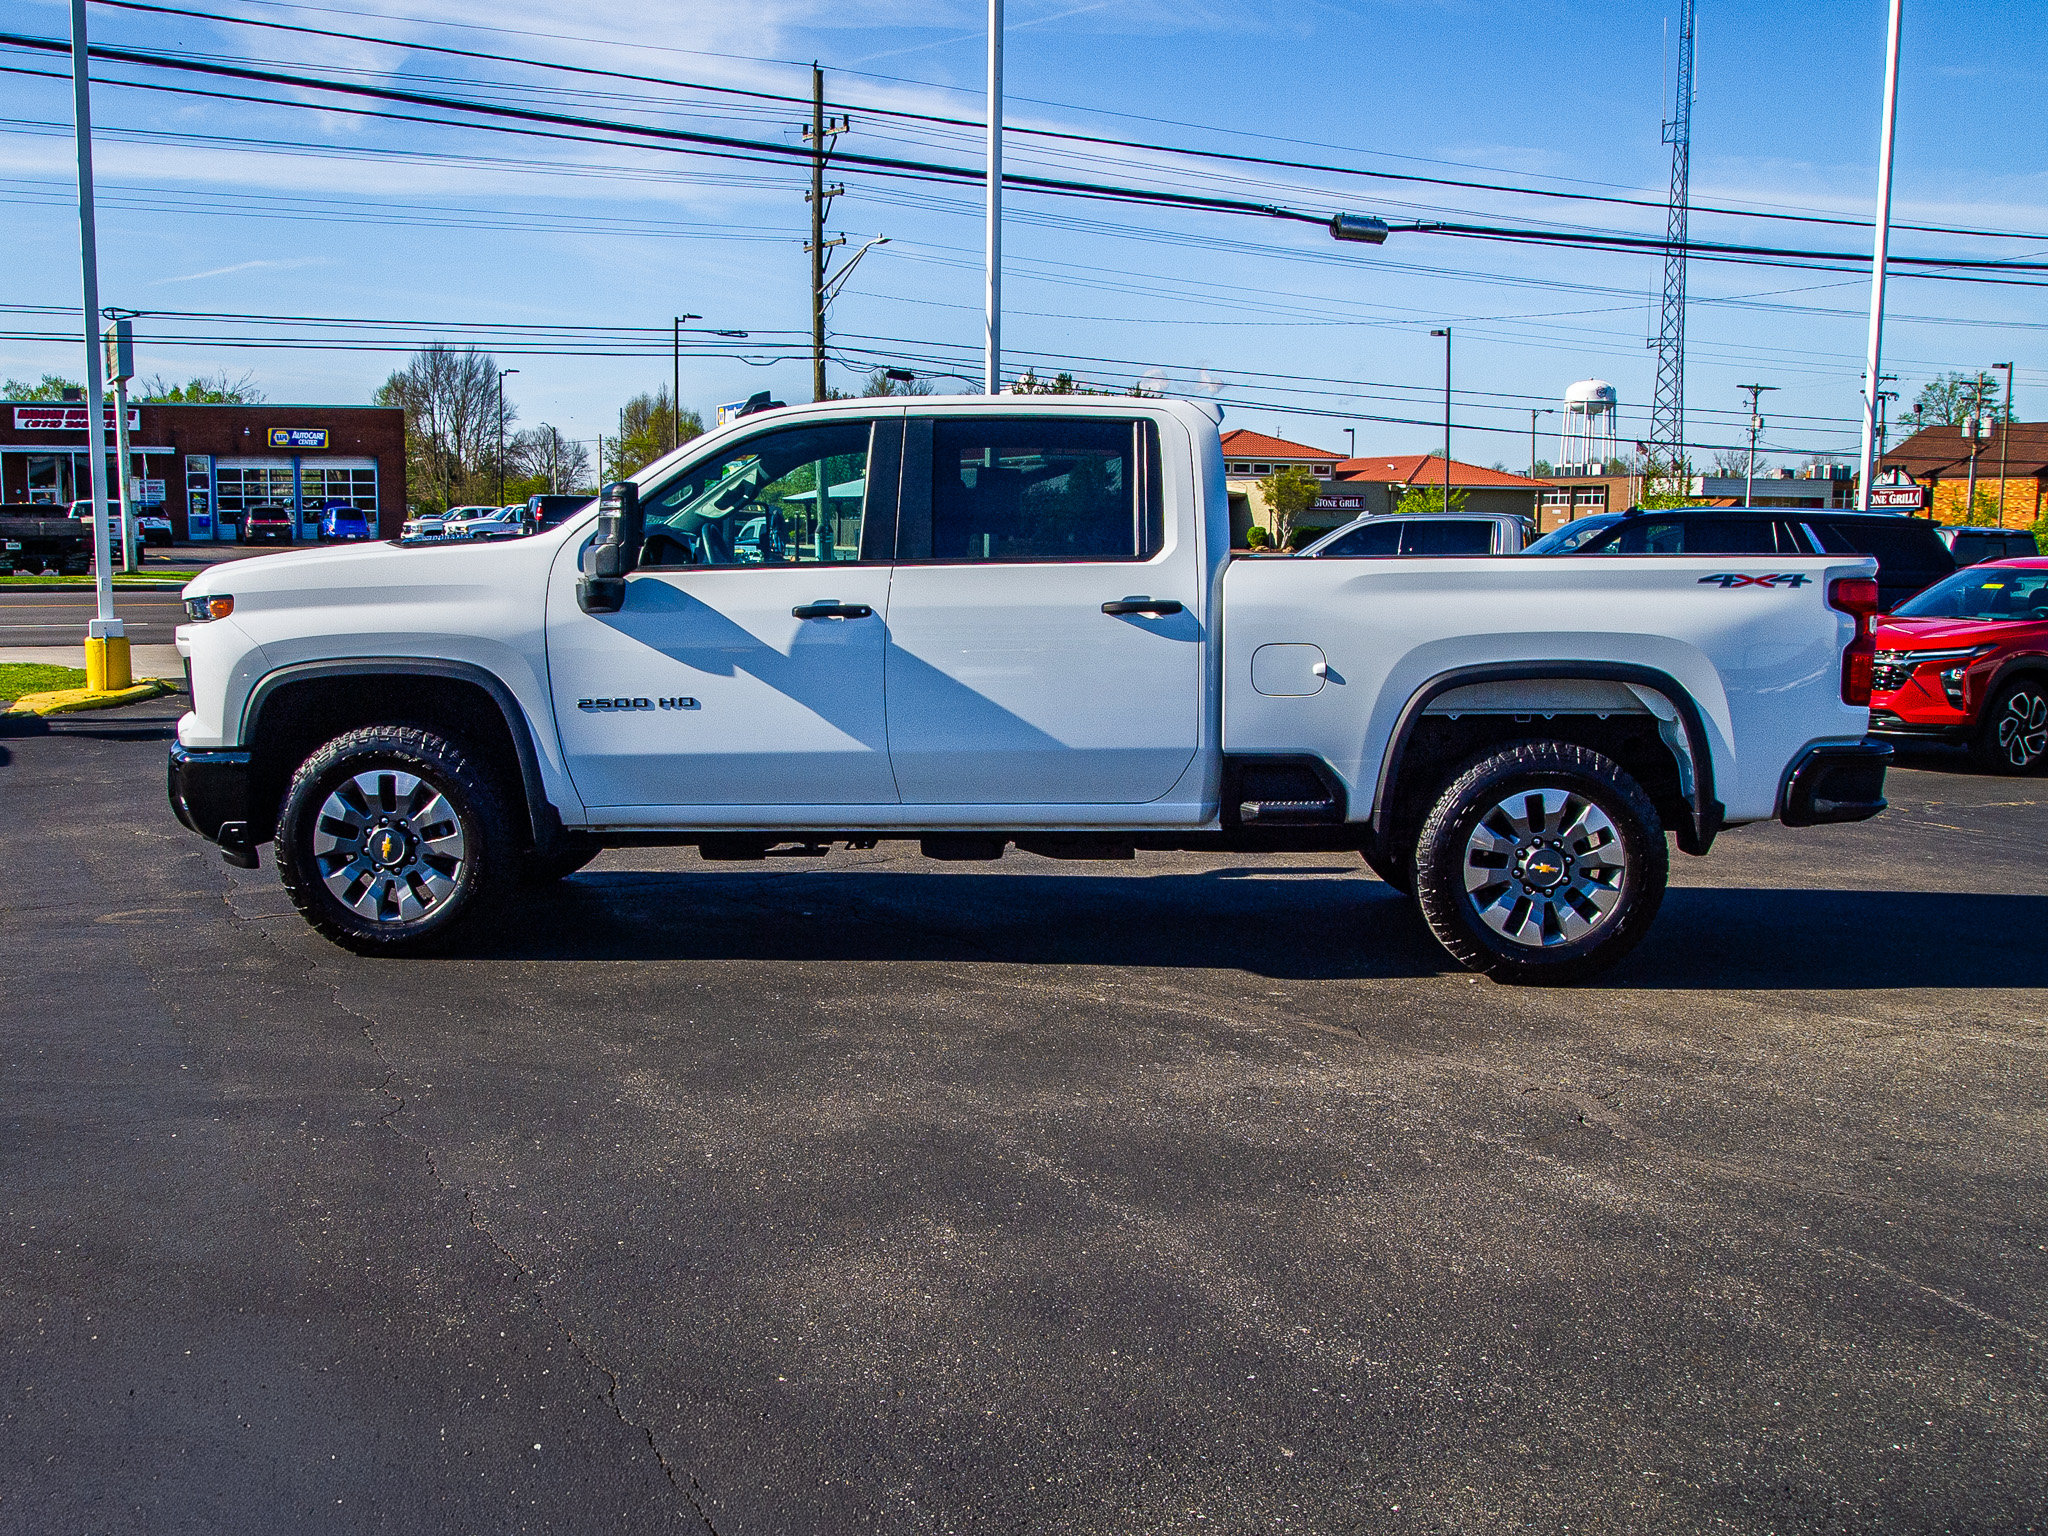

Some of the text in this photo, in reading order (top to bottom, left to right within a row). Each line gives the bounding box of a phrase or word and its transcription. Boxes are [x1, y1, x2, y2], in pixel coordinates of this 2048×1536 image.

[1339, 499, 1359, 507] GRILL
[1889, 493, 1914, 504] GRILL
[577, 697, 695, 708] 2500 HD
